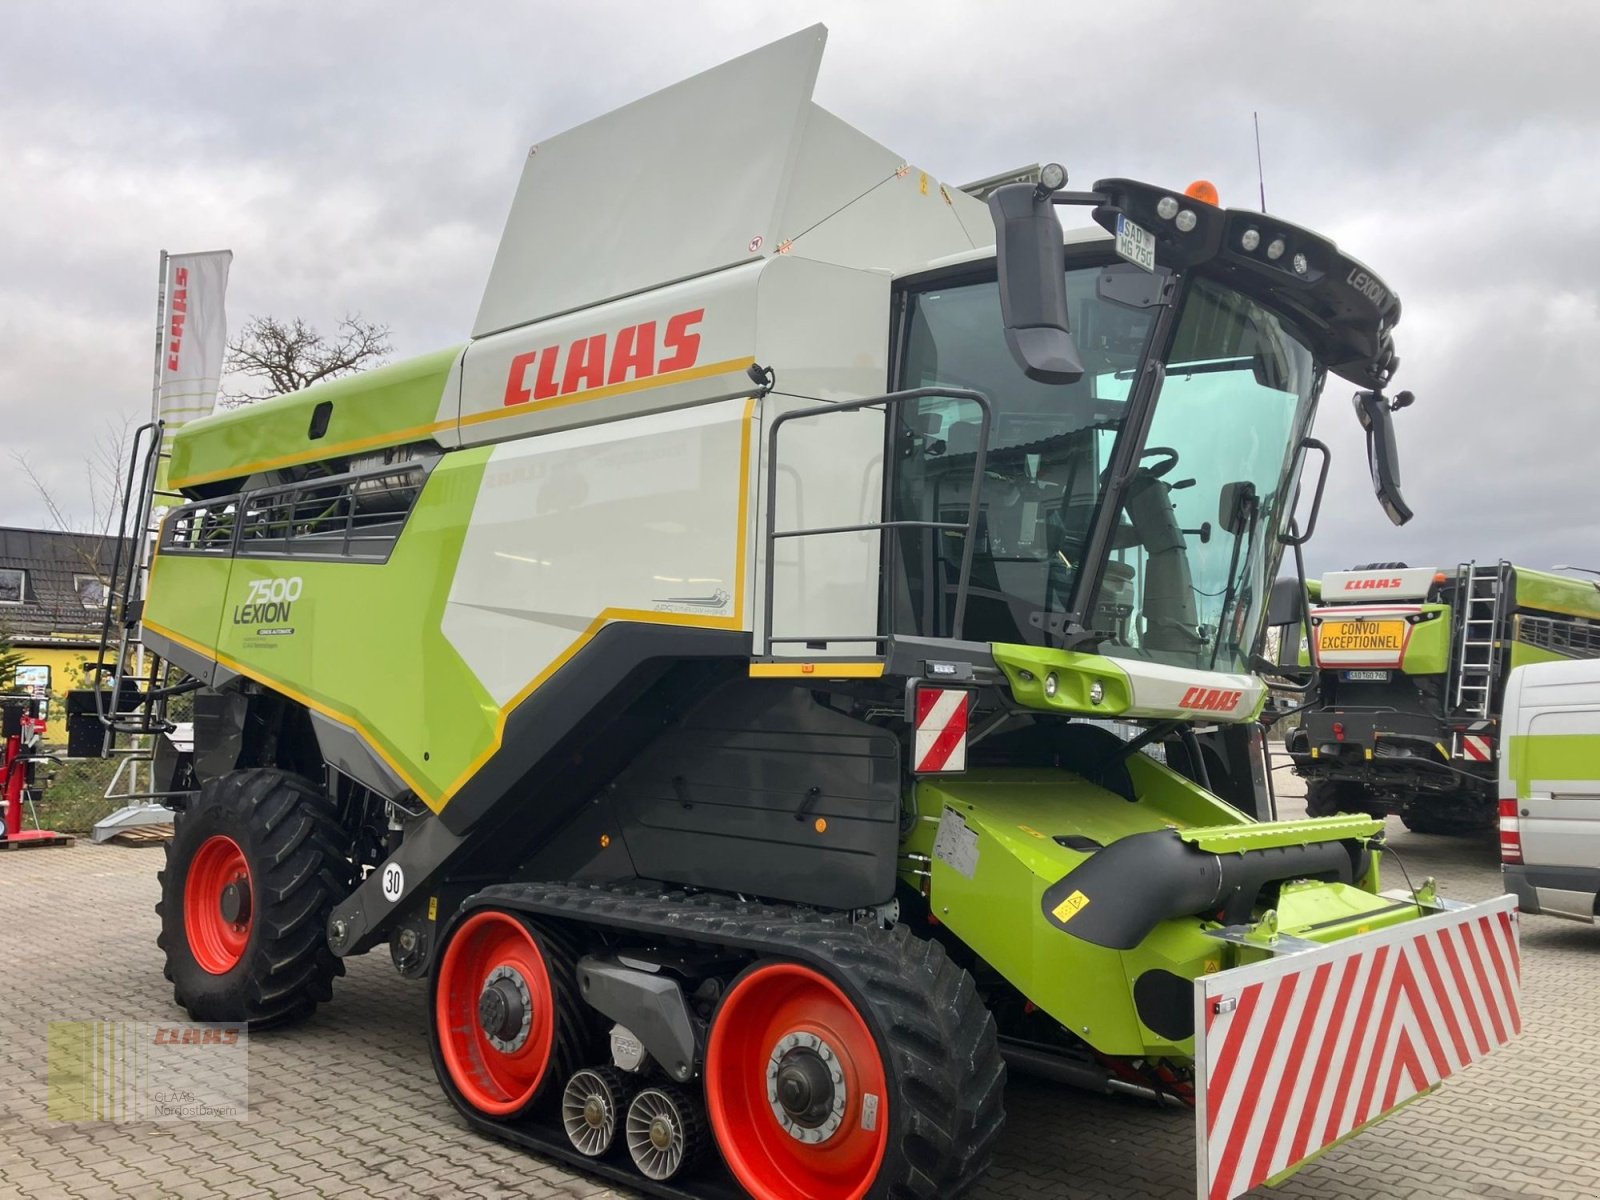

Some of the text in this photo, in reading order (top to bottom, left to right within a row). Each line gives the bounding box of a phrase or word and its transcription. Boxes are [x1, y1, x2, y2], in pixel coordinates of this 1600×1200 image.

[1125, 221, 1143, 244] SAD
[1121, 236, 1152, 267] MG 750
[1346, 267, 1386, 306] LEXION
[168, 267, 189, 371] CLAAS
[504, 308, 705, 407] CLAAS
[246, 576, 303, 605] 7500
[1344, 578, 1402, 590] CLAAS
[233, 601, 291, 624] LEXION
[1341, 623, 1380, 635] CONVOI
[1321, 636, 1399, 649] EXCEPTIONNEL
[1178, 687, 1242, 711] CLAAS
[386, 870, 400, 894] 30
